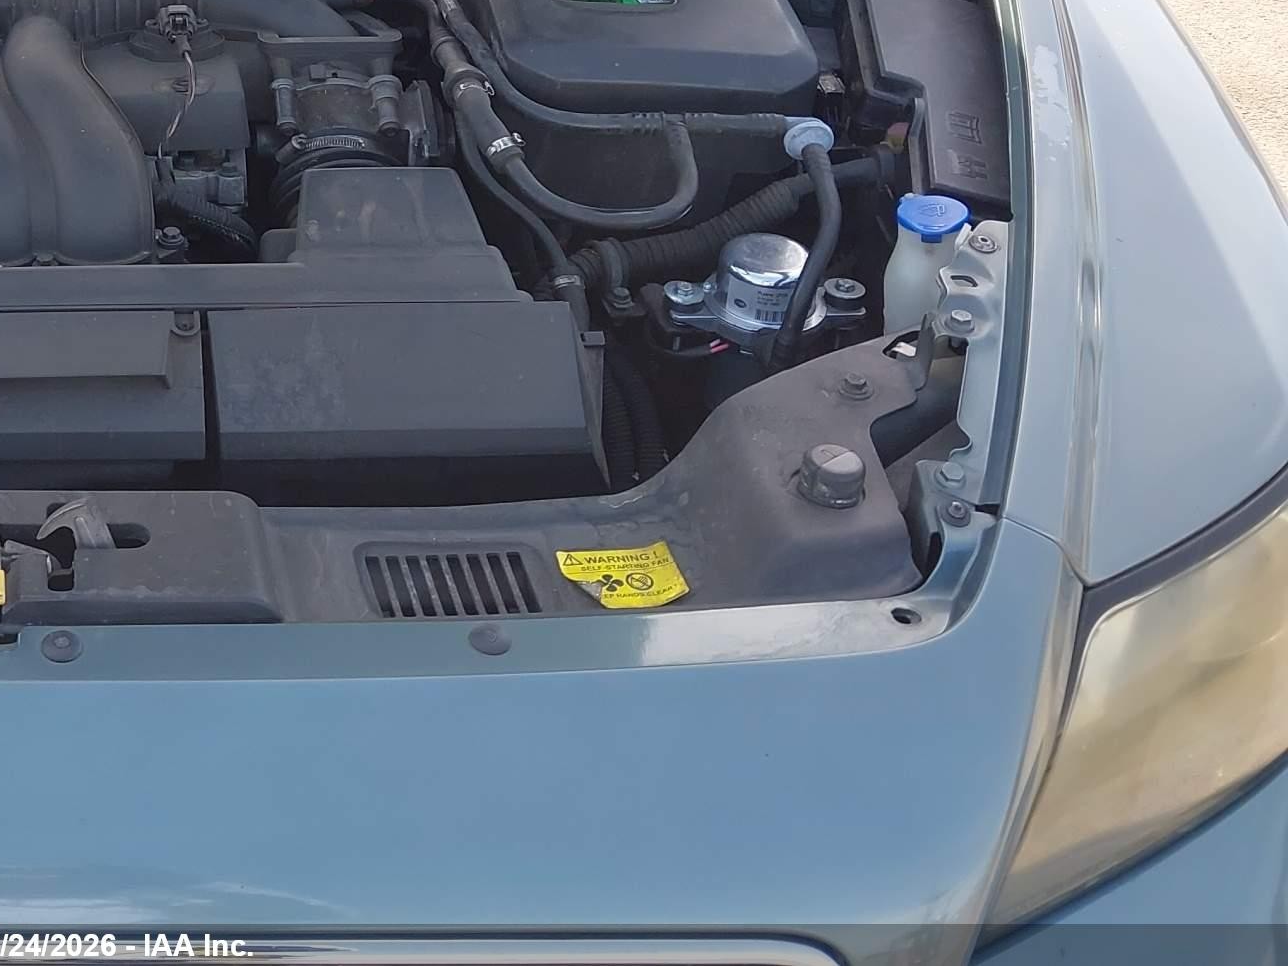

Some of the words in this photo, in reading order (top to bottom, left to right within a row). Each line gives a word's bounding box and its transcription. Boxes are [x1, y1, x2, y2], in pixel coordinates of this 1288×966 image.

[584, 553, 650, 564] WARNING
[651, 558, 669, 566] FAN
[647, 585, 673, 596] CLEAR
